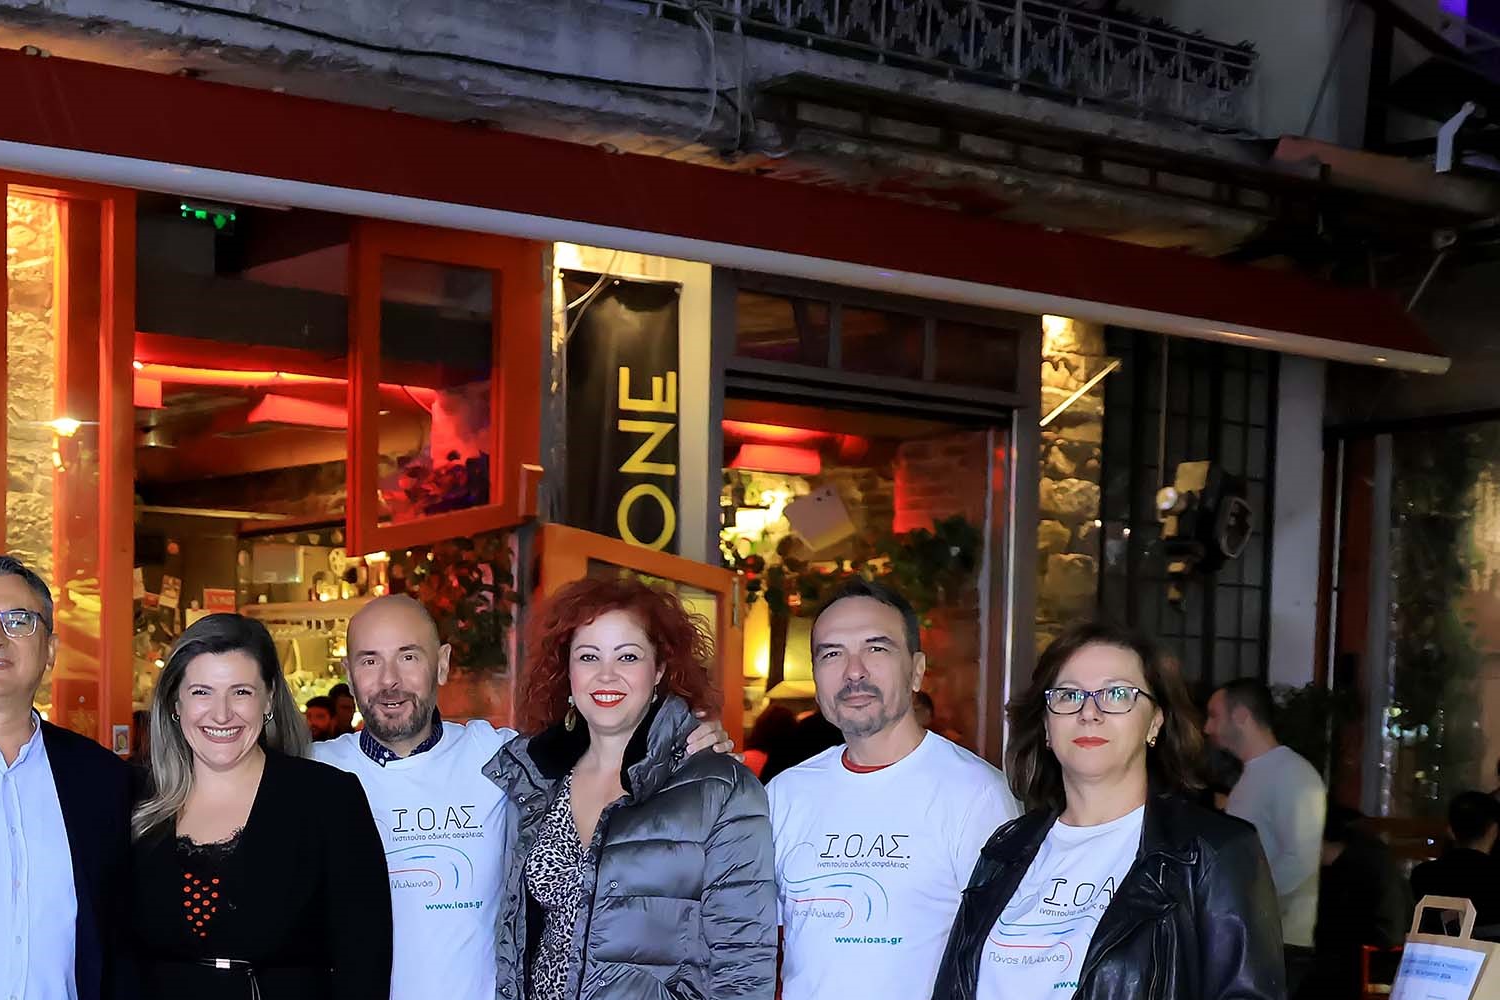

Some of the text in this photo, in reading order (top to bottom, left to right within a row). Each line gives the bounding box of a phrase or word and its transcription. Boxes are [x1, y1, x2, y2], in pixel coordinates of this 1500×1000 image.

[617, 366, 677, 551] ONE
[425, 900, 483, 910] www.ioas.gr
[835, 935, 903, 945] www.ioas.gr
